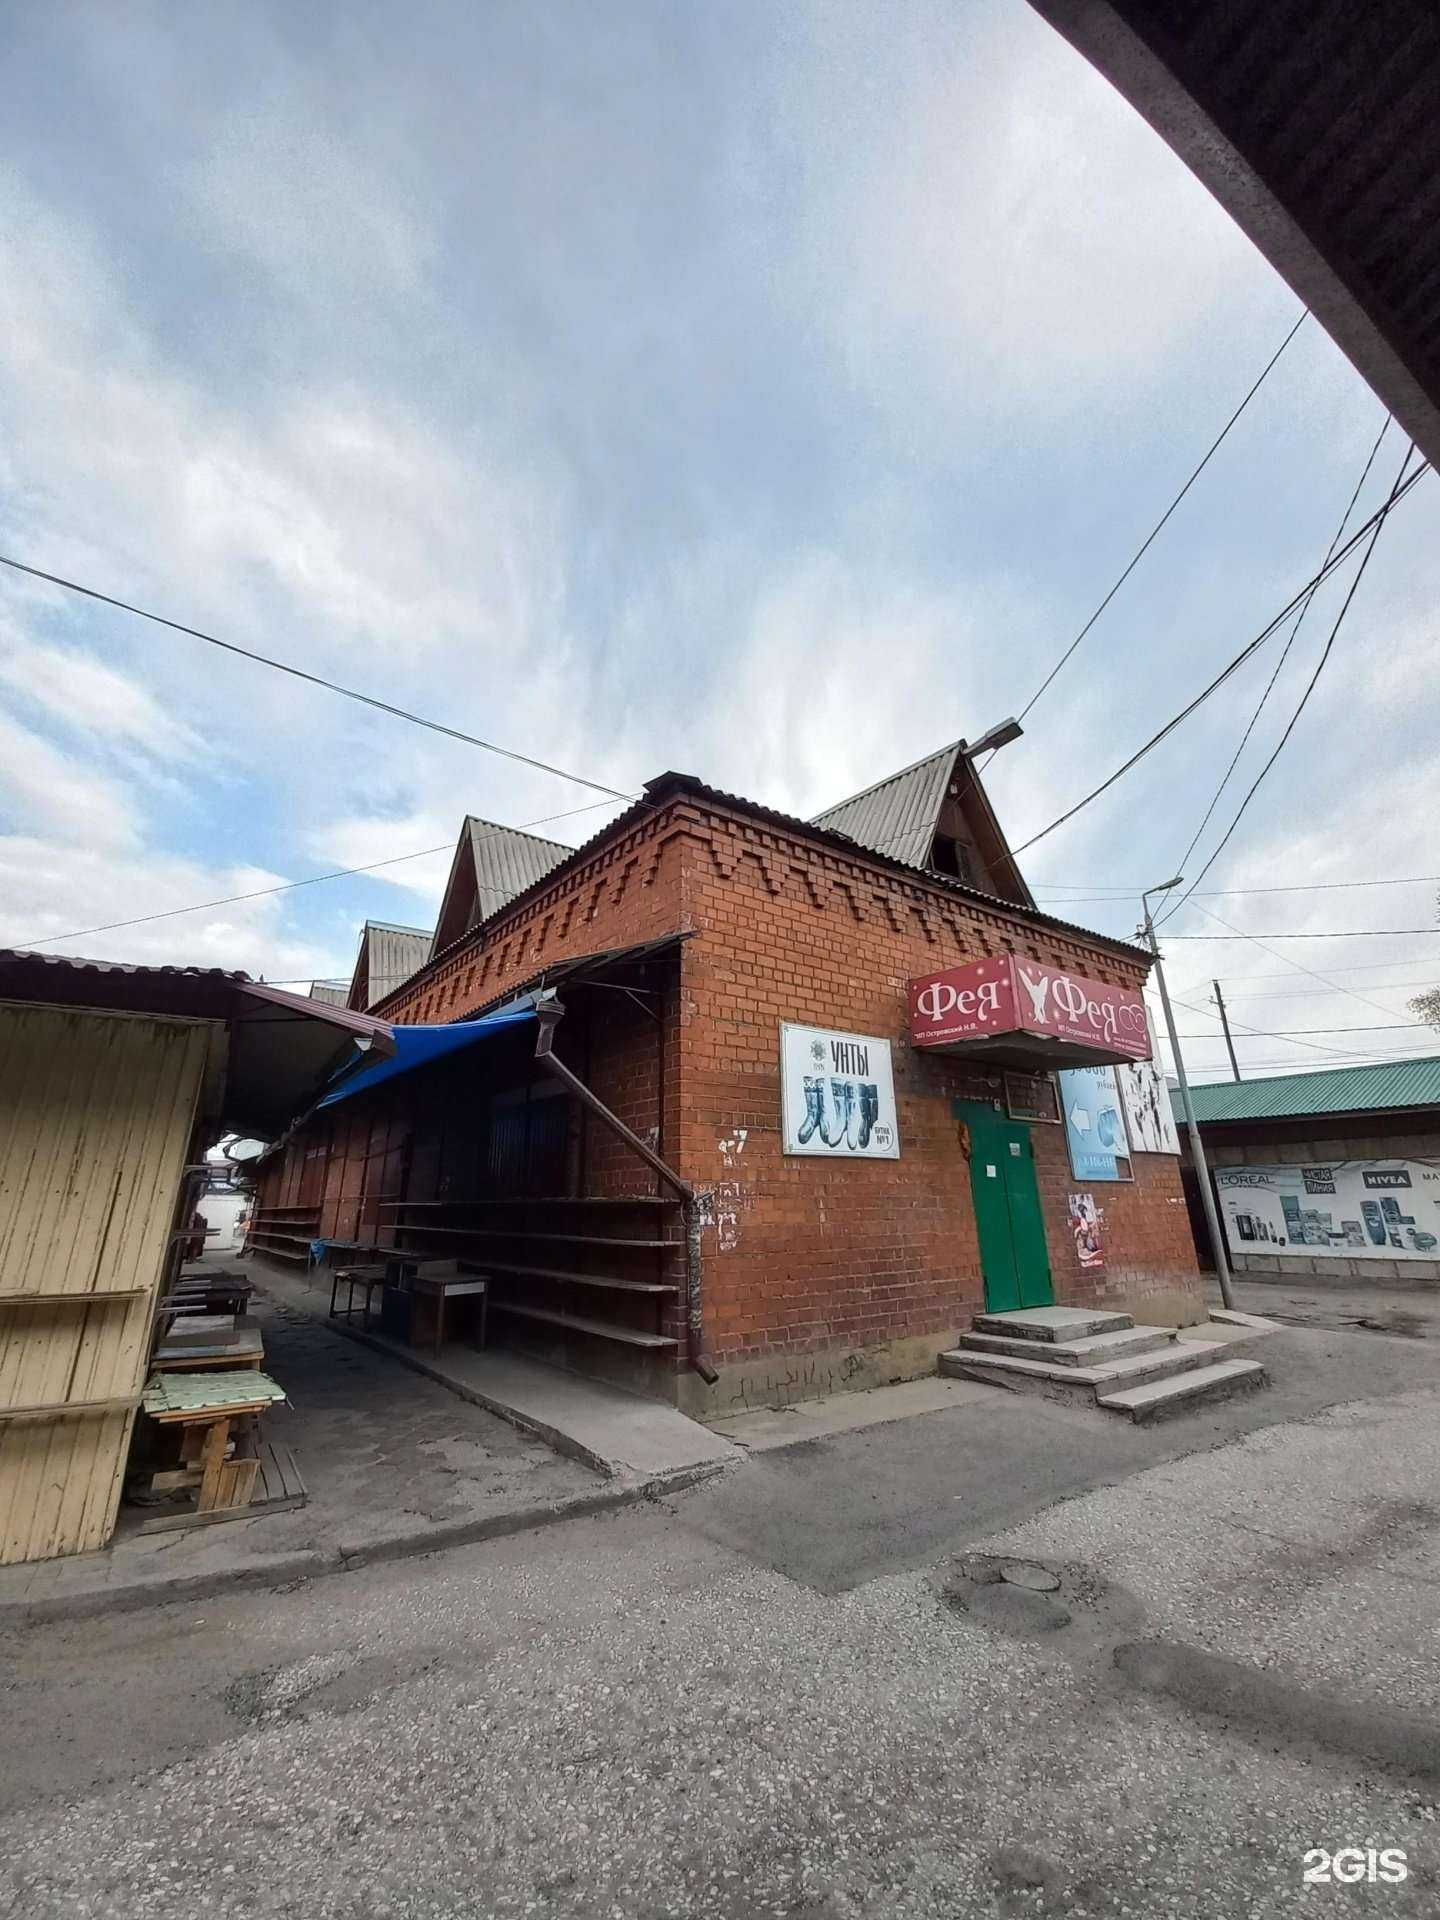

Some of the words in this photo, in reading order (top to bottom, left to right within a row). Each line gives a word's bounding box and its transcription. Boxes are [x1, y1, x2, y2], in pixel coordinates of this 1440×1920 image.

[830, 1040, 870, 1077] УНТЫ
[1367, 1176, 1408, 1185] NIVEA
[1307, 1182, 1335, 1194] ЛИНИЯ
